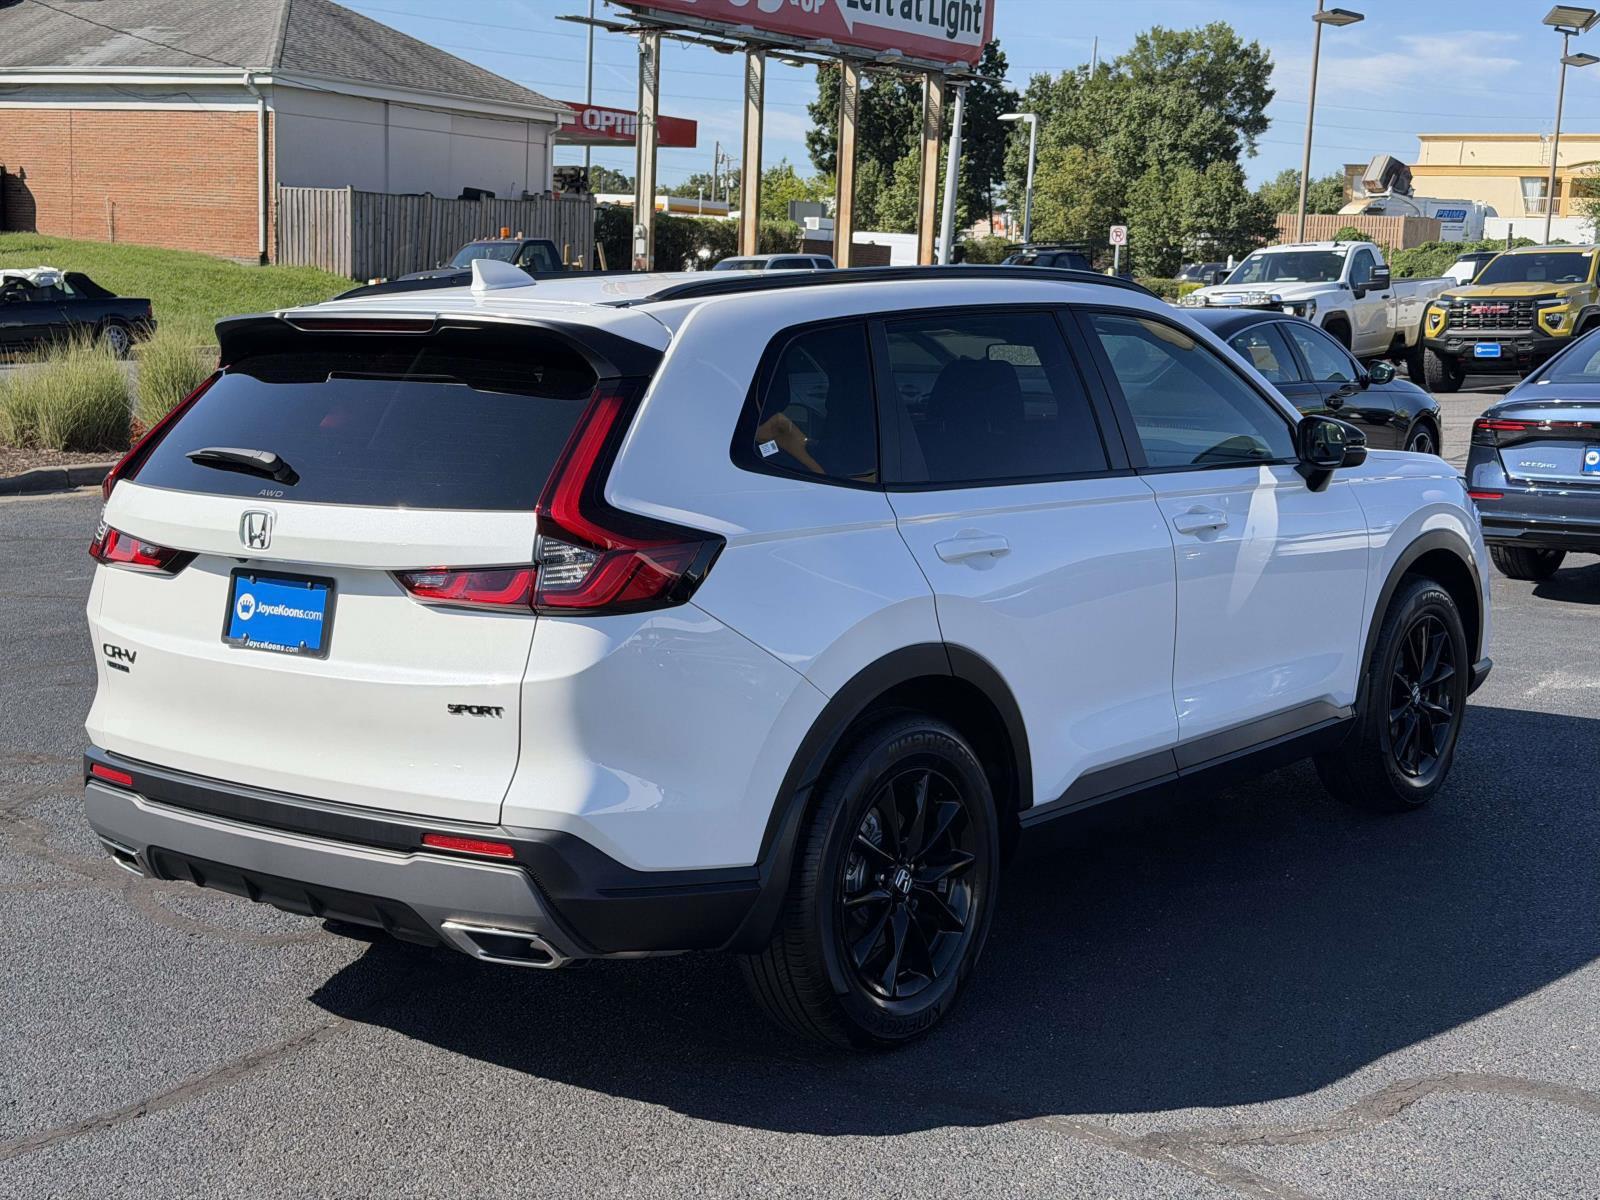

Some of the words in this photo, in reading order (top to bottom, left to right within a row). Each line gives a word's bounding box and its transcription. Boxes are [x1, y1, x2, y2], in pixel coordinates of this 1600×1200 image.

[847, 0, 894, 16] et
[900, 0, 923, 22] at
[929, 0, 982, 39] Light
[583, 109, 637, 136] OPTI
[257, 489, 284, 497] AWD
[256, 602, 322, 621] JoyceKoons.com
[103, 643, 137, 665] CR-V
[245, 639, 299, 653] JoyceKoons.com
[447, 703, 504, 716] SPORT
